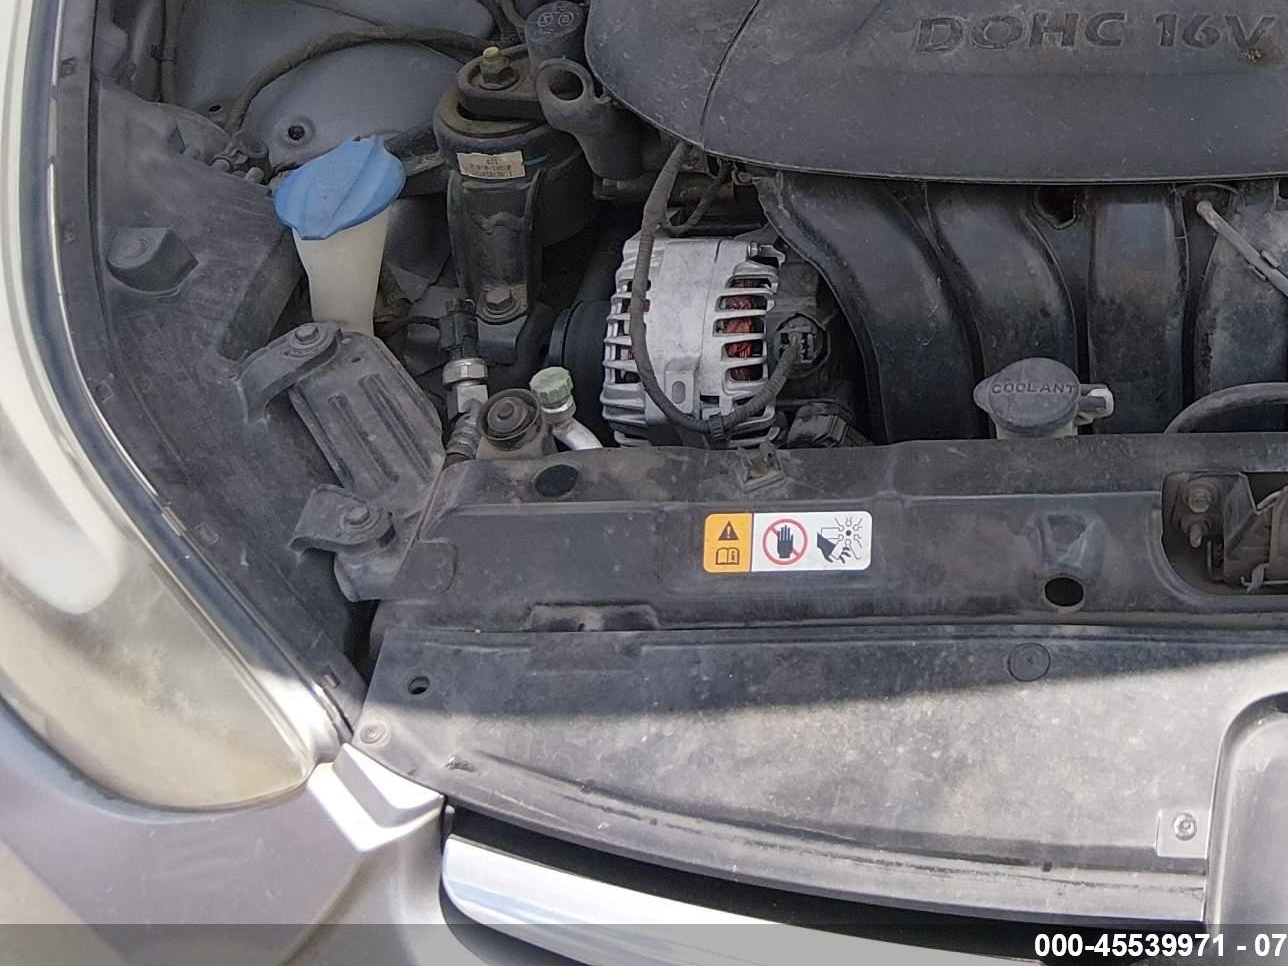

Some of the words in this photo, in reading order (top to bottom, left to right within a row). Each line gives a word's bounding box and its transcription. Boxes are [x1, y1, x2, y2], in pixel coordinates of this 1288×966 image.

[914, 11, 1127, 54] DOHC
[1153, 12, 1277, 50] 16V
[991, 382, 1077, 395] COOLANT
